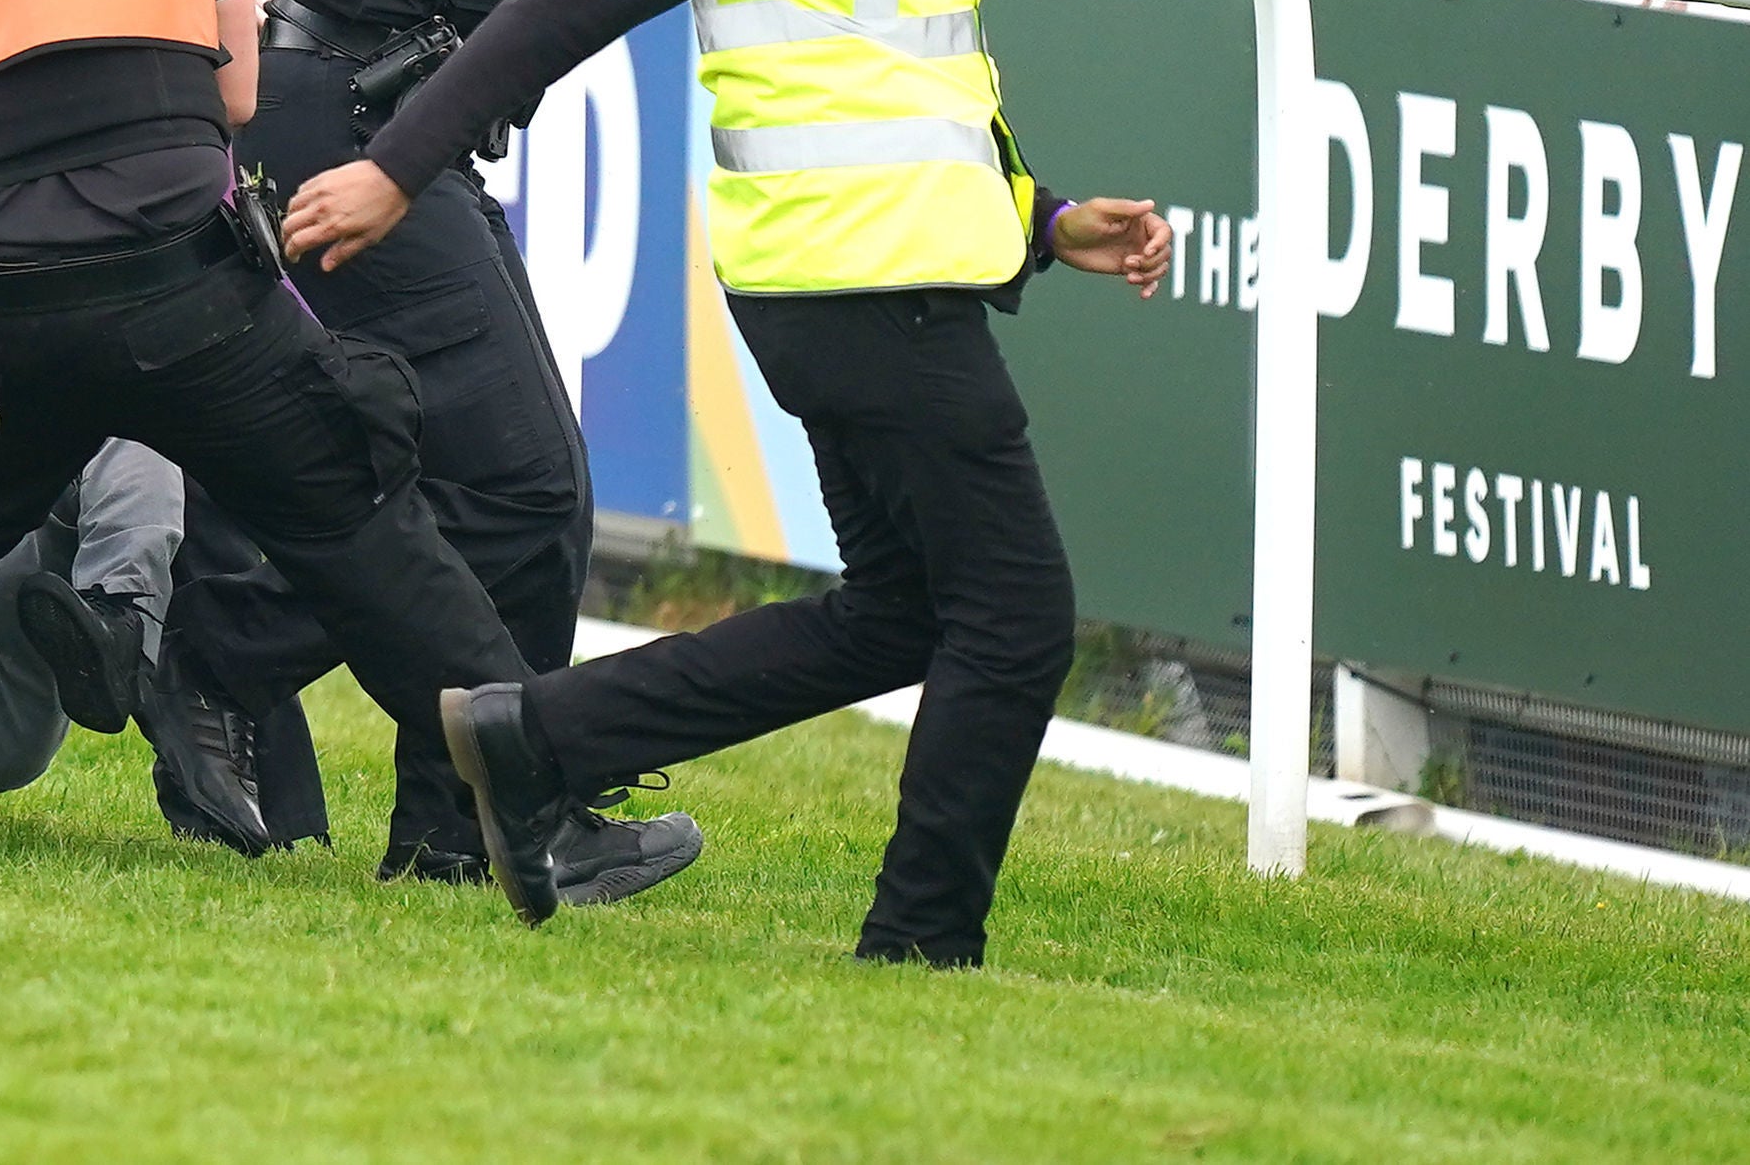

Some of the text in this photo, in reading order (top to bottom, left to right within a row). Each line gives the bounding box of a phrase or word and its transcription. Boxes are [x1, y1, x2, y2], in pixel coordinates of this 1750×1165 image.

[1166, 78, 1743, 379] THE DERBY
[1401, 456, 1651, 591] FESTIVAL
